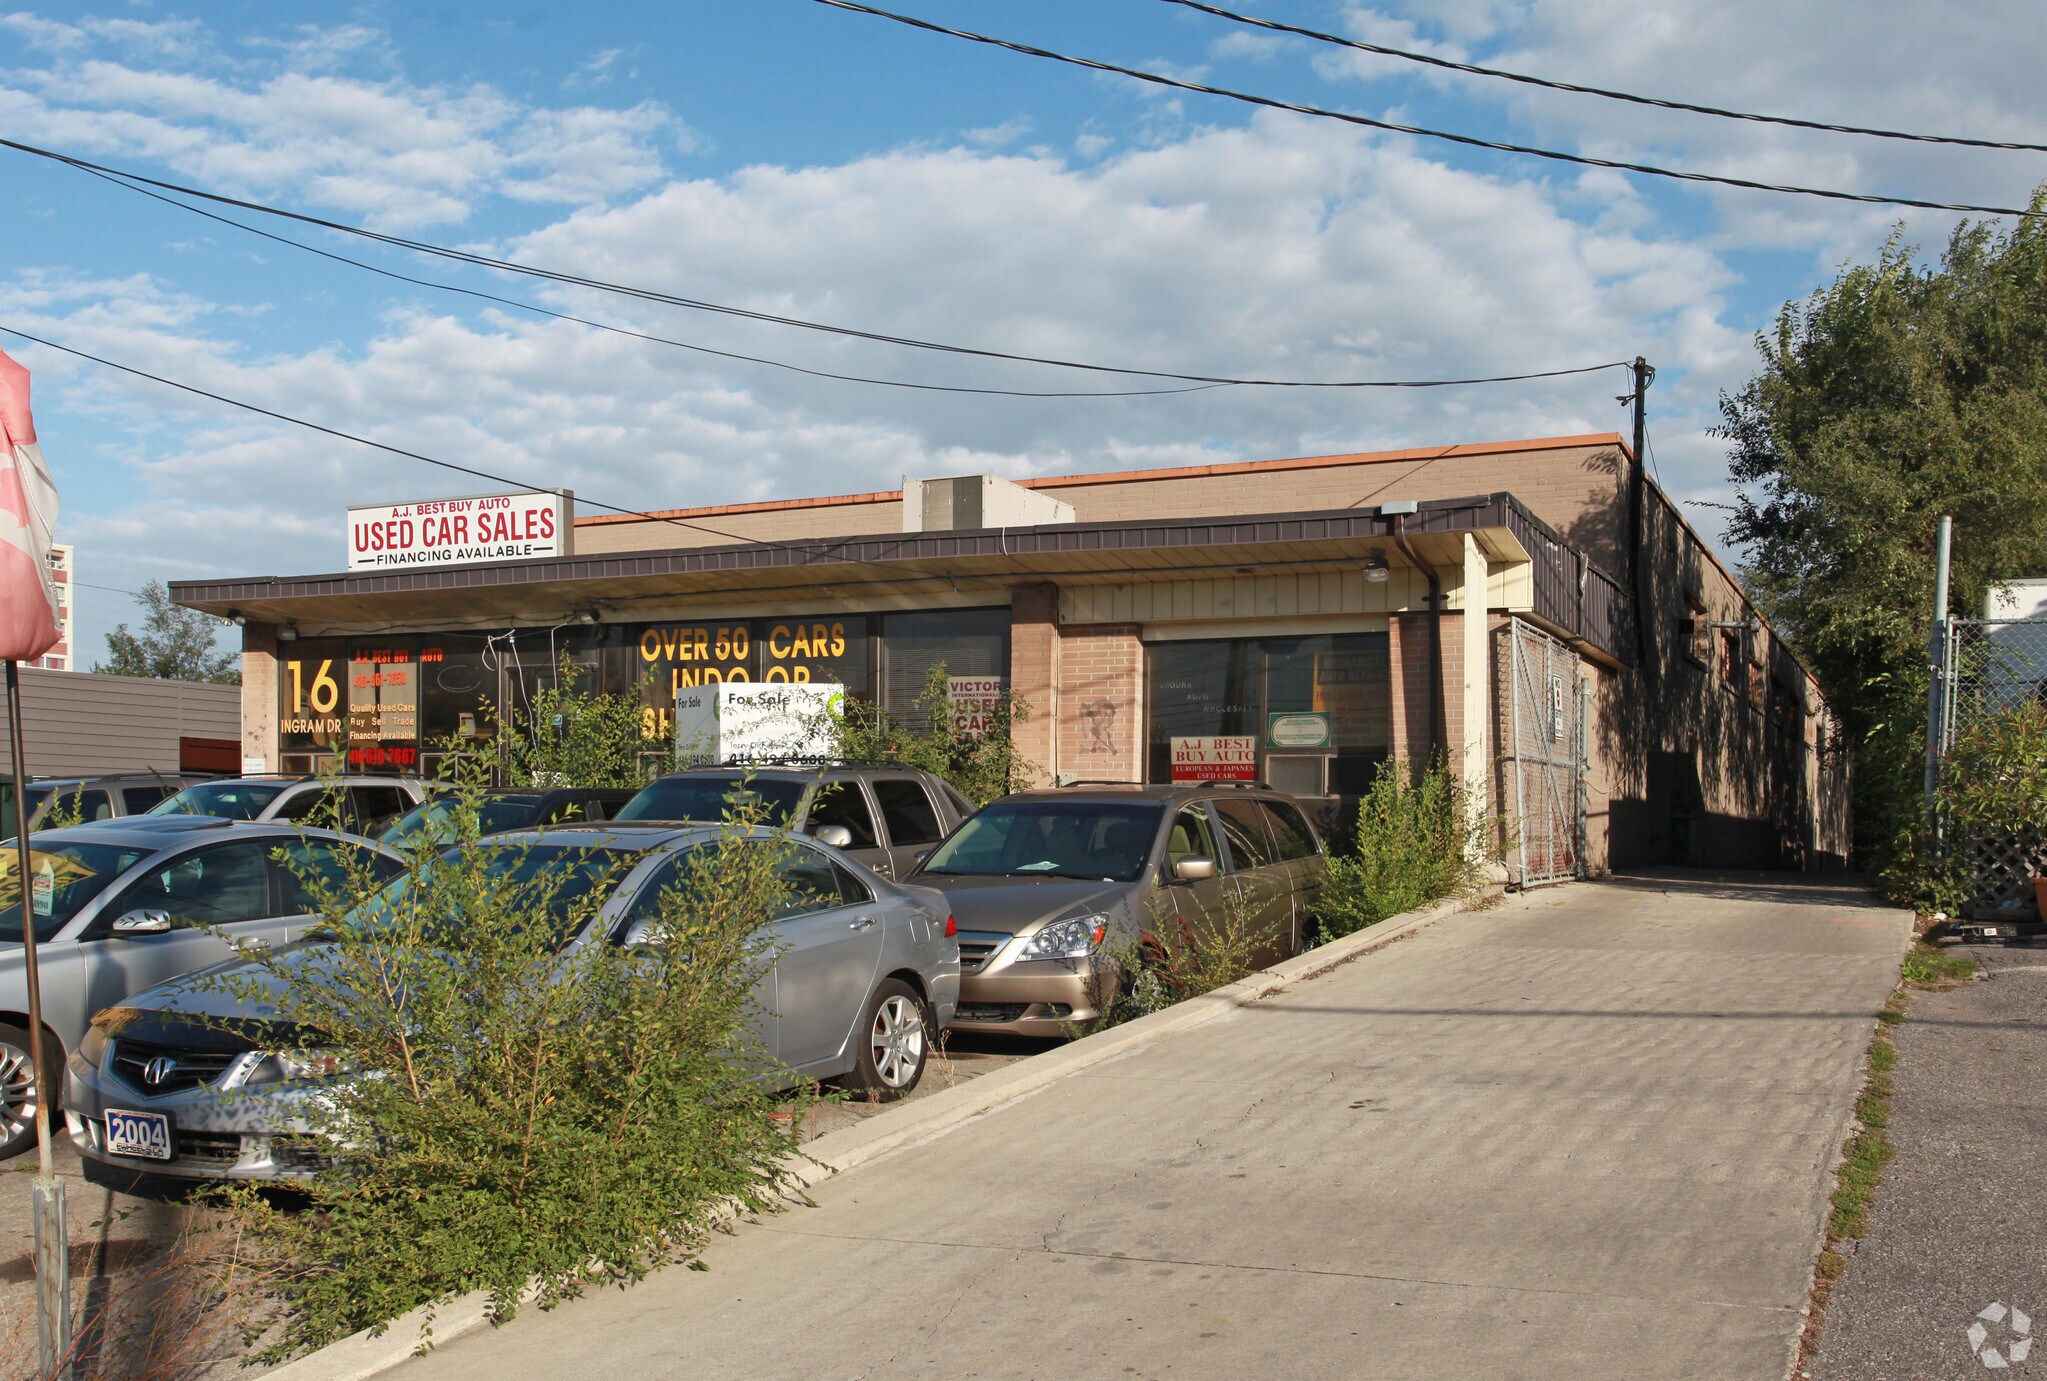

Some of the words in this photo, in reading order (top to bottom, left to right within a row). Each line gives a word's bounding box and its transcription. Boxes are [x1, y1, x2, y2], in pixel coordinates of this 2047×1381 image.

[392, 507, 412, 518] A.J.
[417, 502, 446, 516] BEST
[449, 500, 473, 512] BUY
[478, 497, 510, 510] AUTO
[355, 520, 414, 552] USED
[422, 515, 469, 547] CAR
[477, 507, 554, 544] SALES
[376, 549, 452, 565] FINANCING
[456, 544, 532, 559] AVAILABLE
[640, 627, 709, 661] OVER
[715, 626, 749, 661] 50
[769, 622, 845, 660] CARS
[287, 659, 338, 714] 16
[678, 697, 688, 709] For
[689, 695, 701, 708] Sale
[728, 693, 752, 704] For
[758, 692, 791, 706] Sale
[350, 703, 376, 713] Quality
[377, 703, 397, 712] Used
[397, 703, 416, 712] Cars
[281, 719, 325, 733] INGRAM
[327, 719, 342, 733] DR
[350, 717, 365, 727] Buy
[371, 717, 386, 726] Sell
[392, 716, 414, 726] Trade
[350, 731, 381, 741] Financing
[383, 731, 415, 739] Available
[1213, 738, 1253, 749] BEST
[1176, 751, 1207, 761] BUY
[1213, 750, 1256, 761] AUTO
[112, 1118, 164, 1148] 2004
